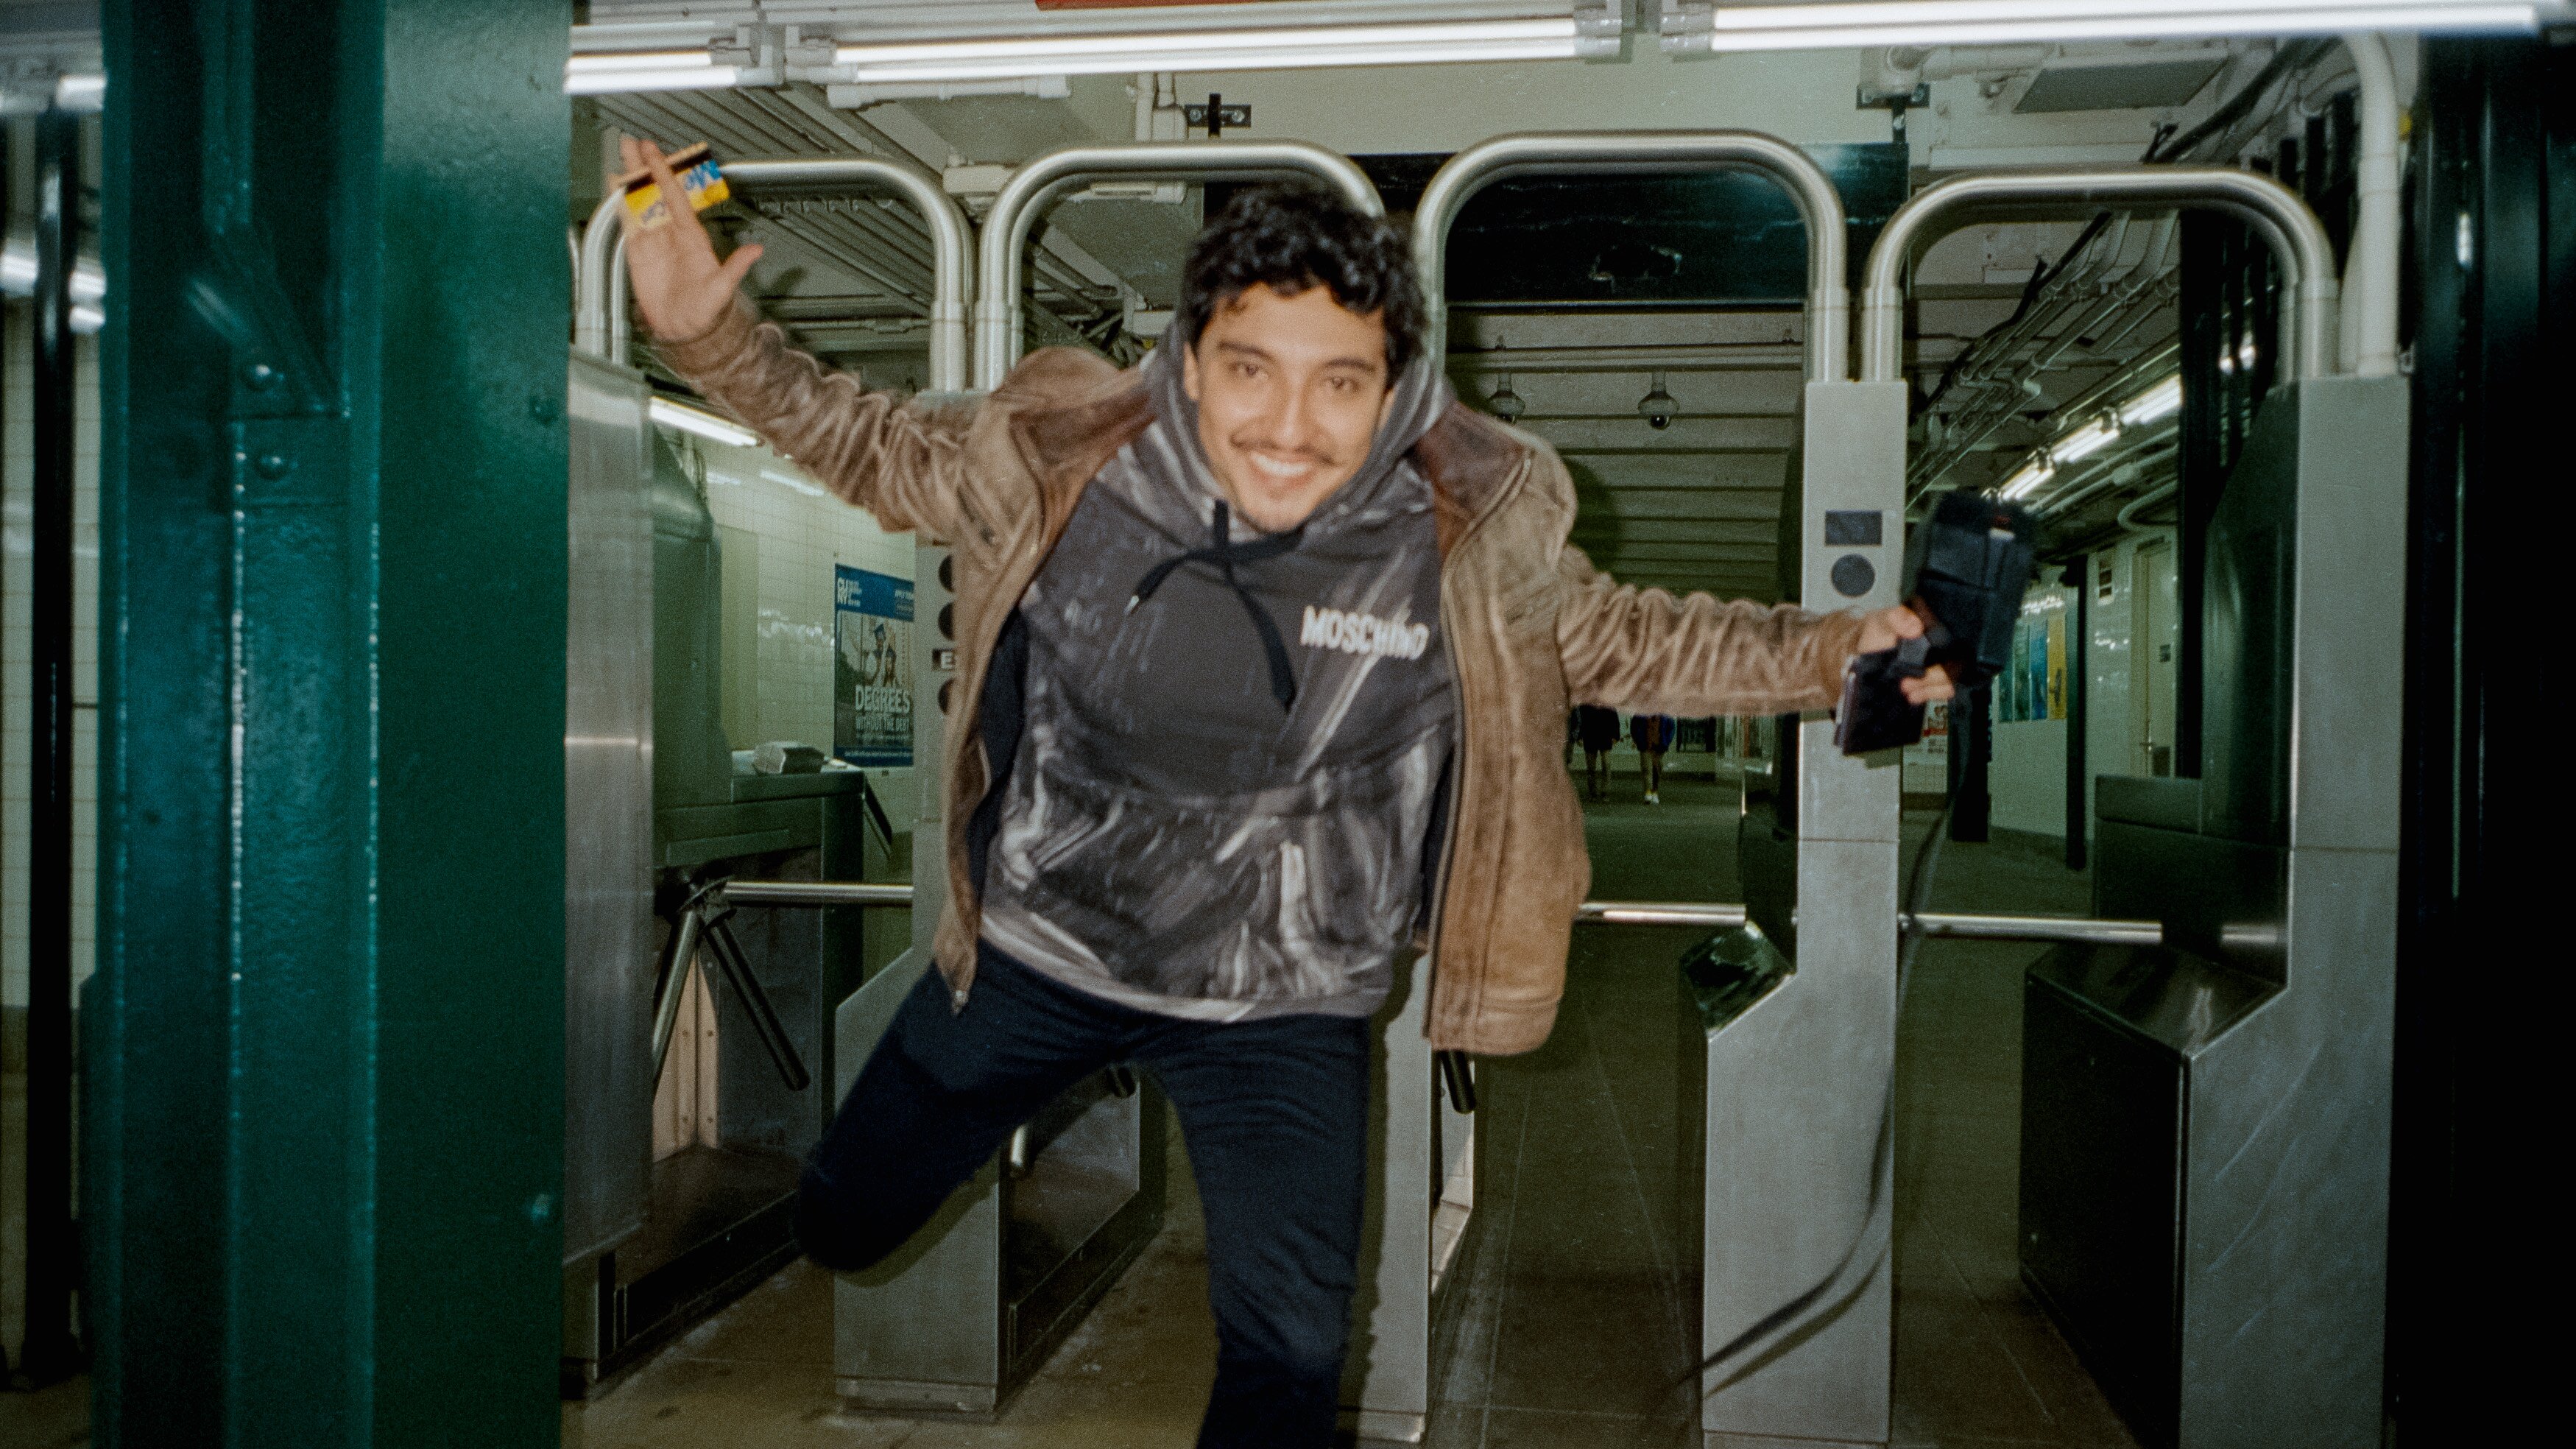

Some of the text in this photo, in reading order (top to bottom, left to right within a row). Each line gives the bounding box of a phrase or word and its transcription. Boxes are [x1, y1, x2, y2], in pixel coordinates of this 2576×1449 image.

[1300, 604, 1430, 660] MOSCHINO
[855, 685, 911, 714] DEGREES
[855, 715, 882, 731] WITHOUT
[883, 716, 894, 731] THE
